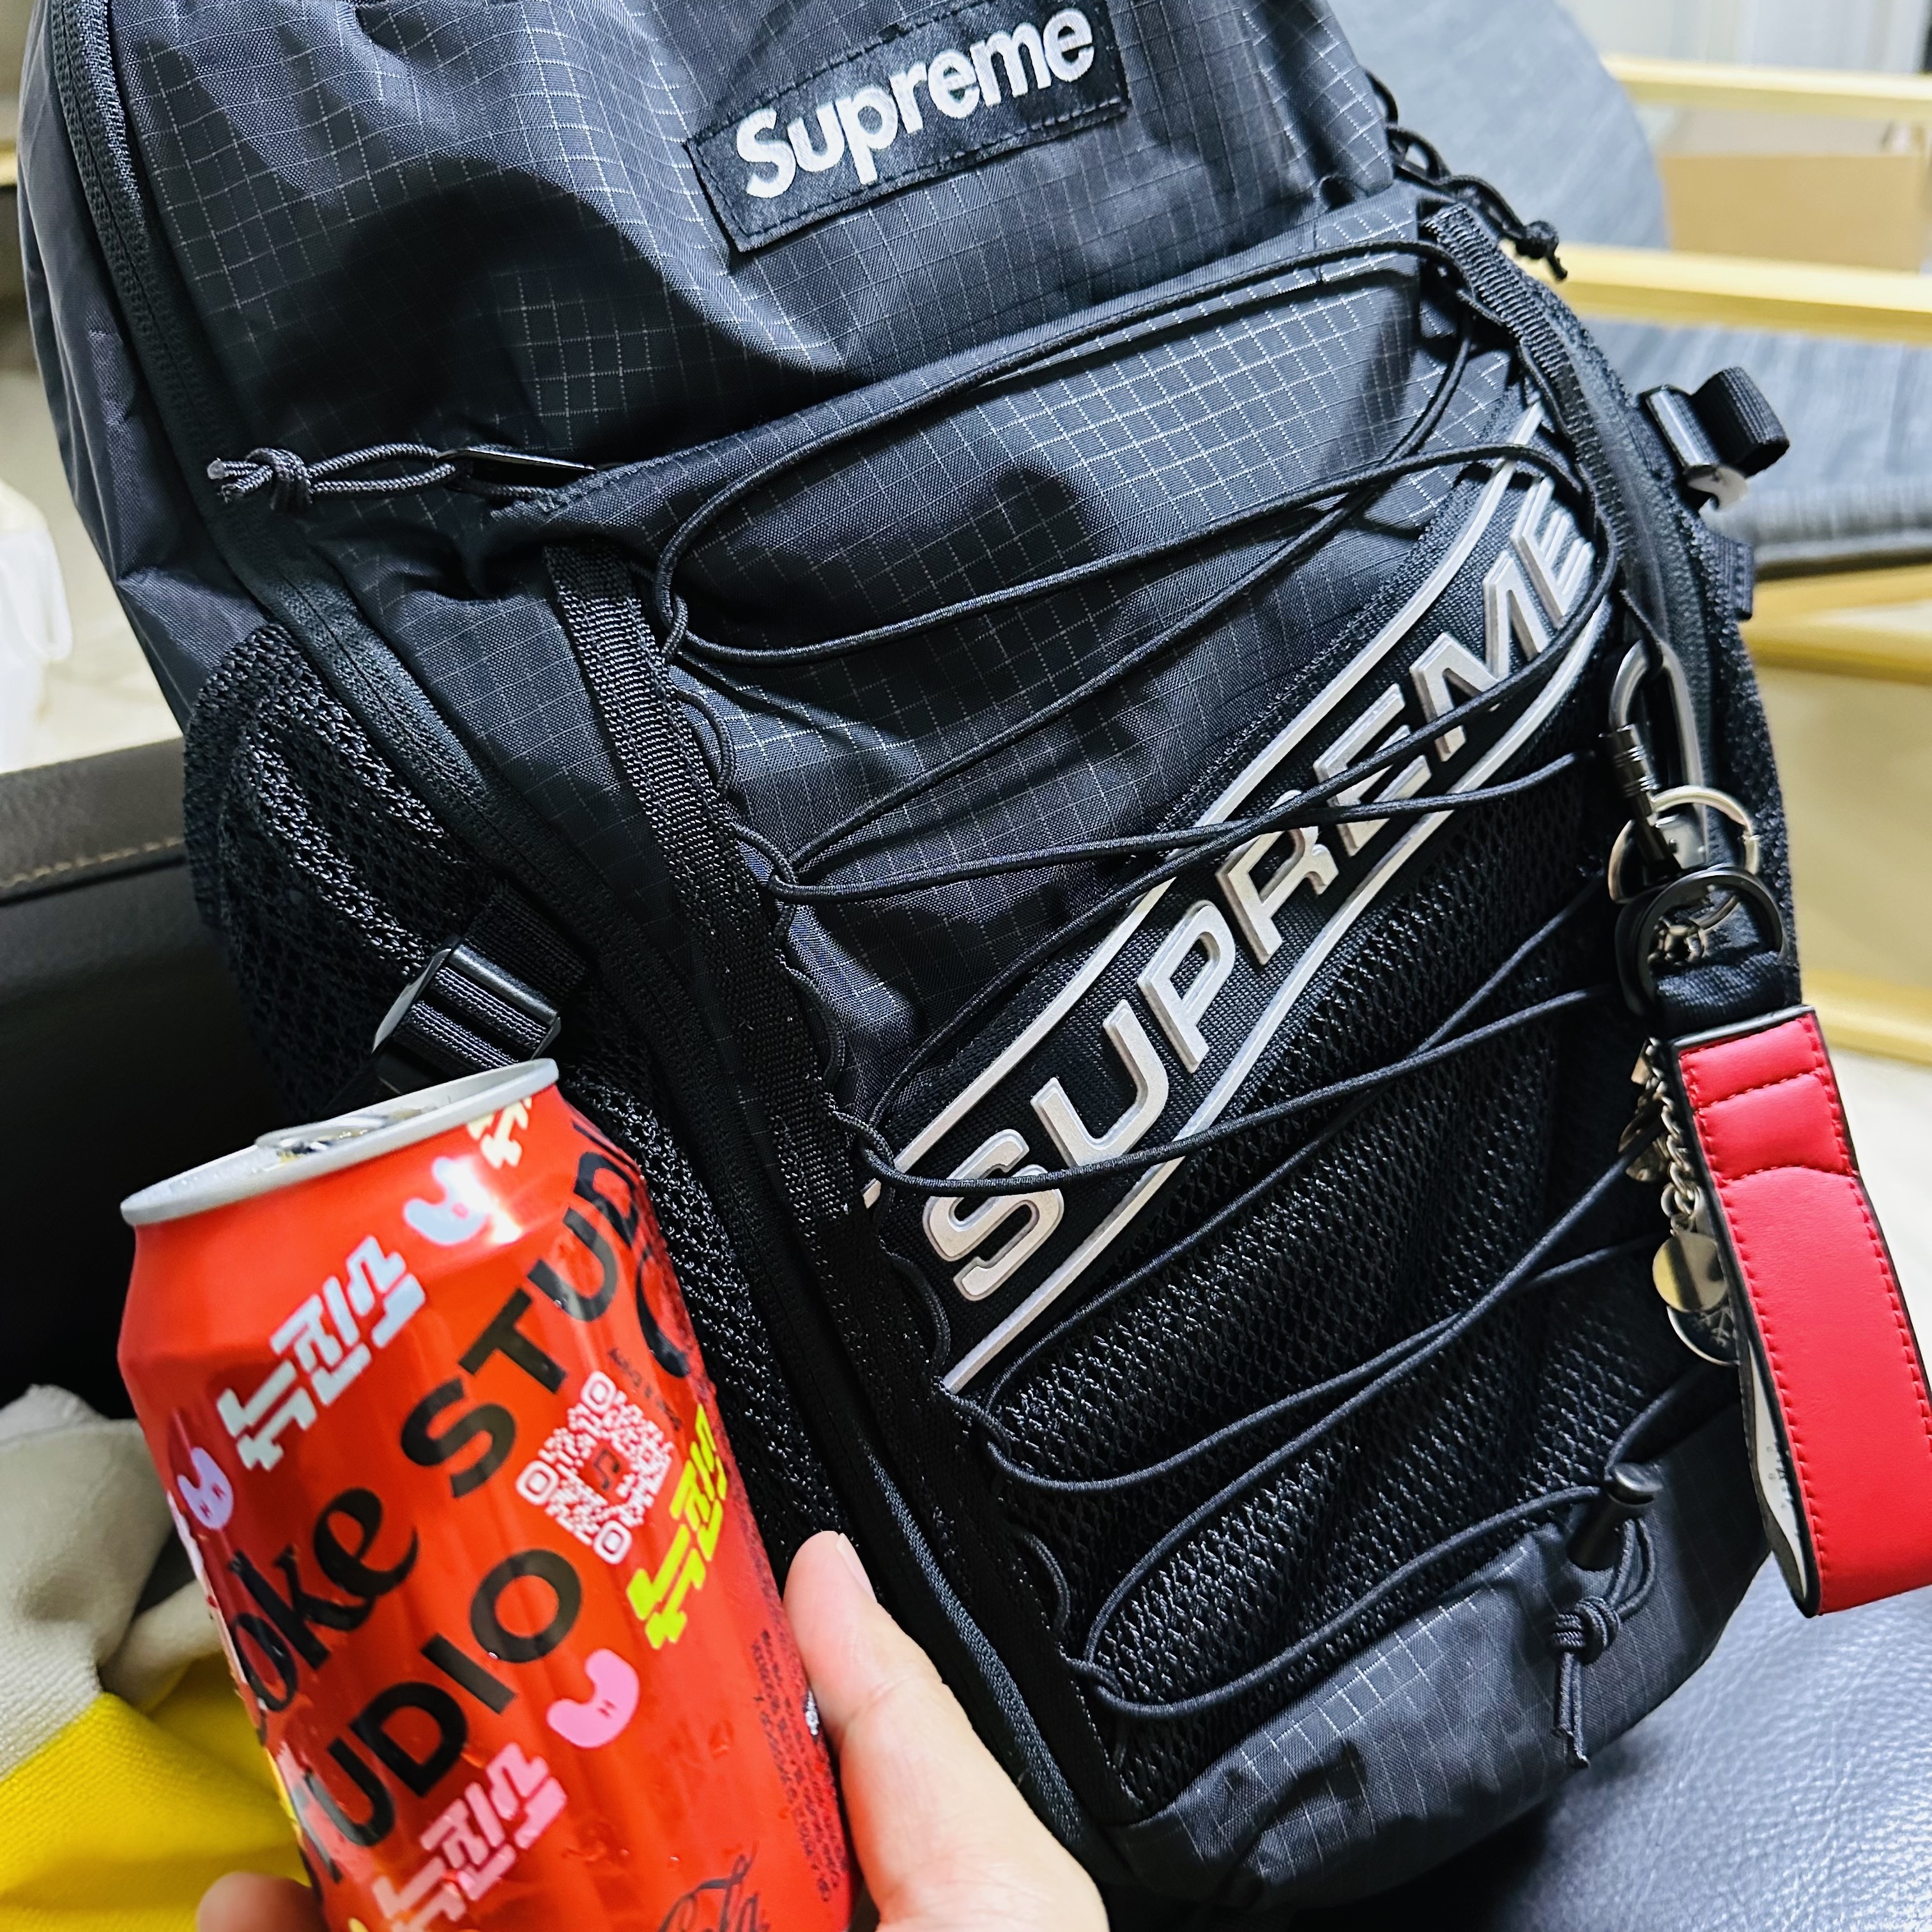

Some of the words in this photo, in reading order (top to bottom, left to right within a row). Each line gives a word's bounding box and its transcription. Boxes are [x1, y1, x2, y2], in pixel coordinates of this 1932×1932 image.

[736, 8, 1094, 199] Supreme
[923, 476, 1595, 1301] SUPREME
[230, 1487, 419, 1747] oke
